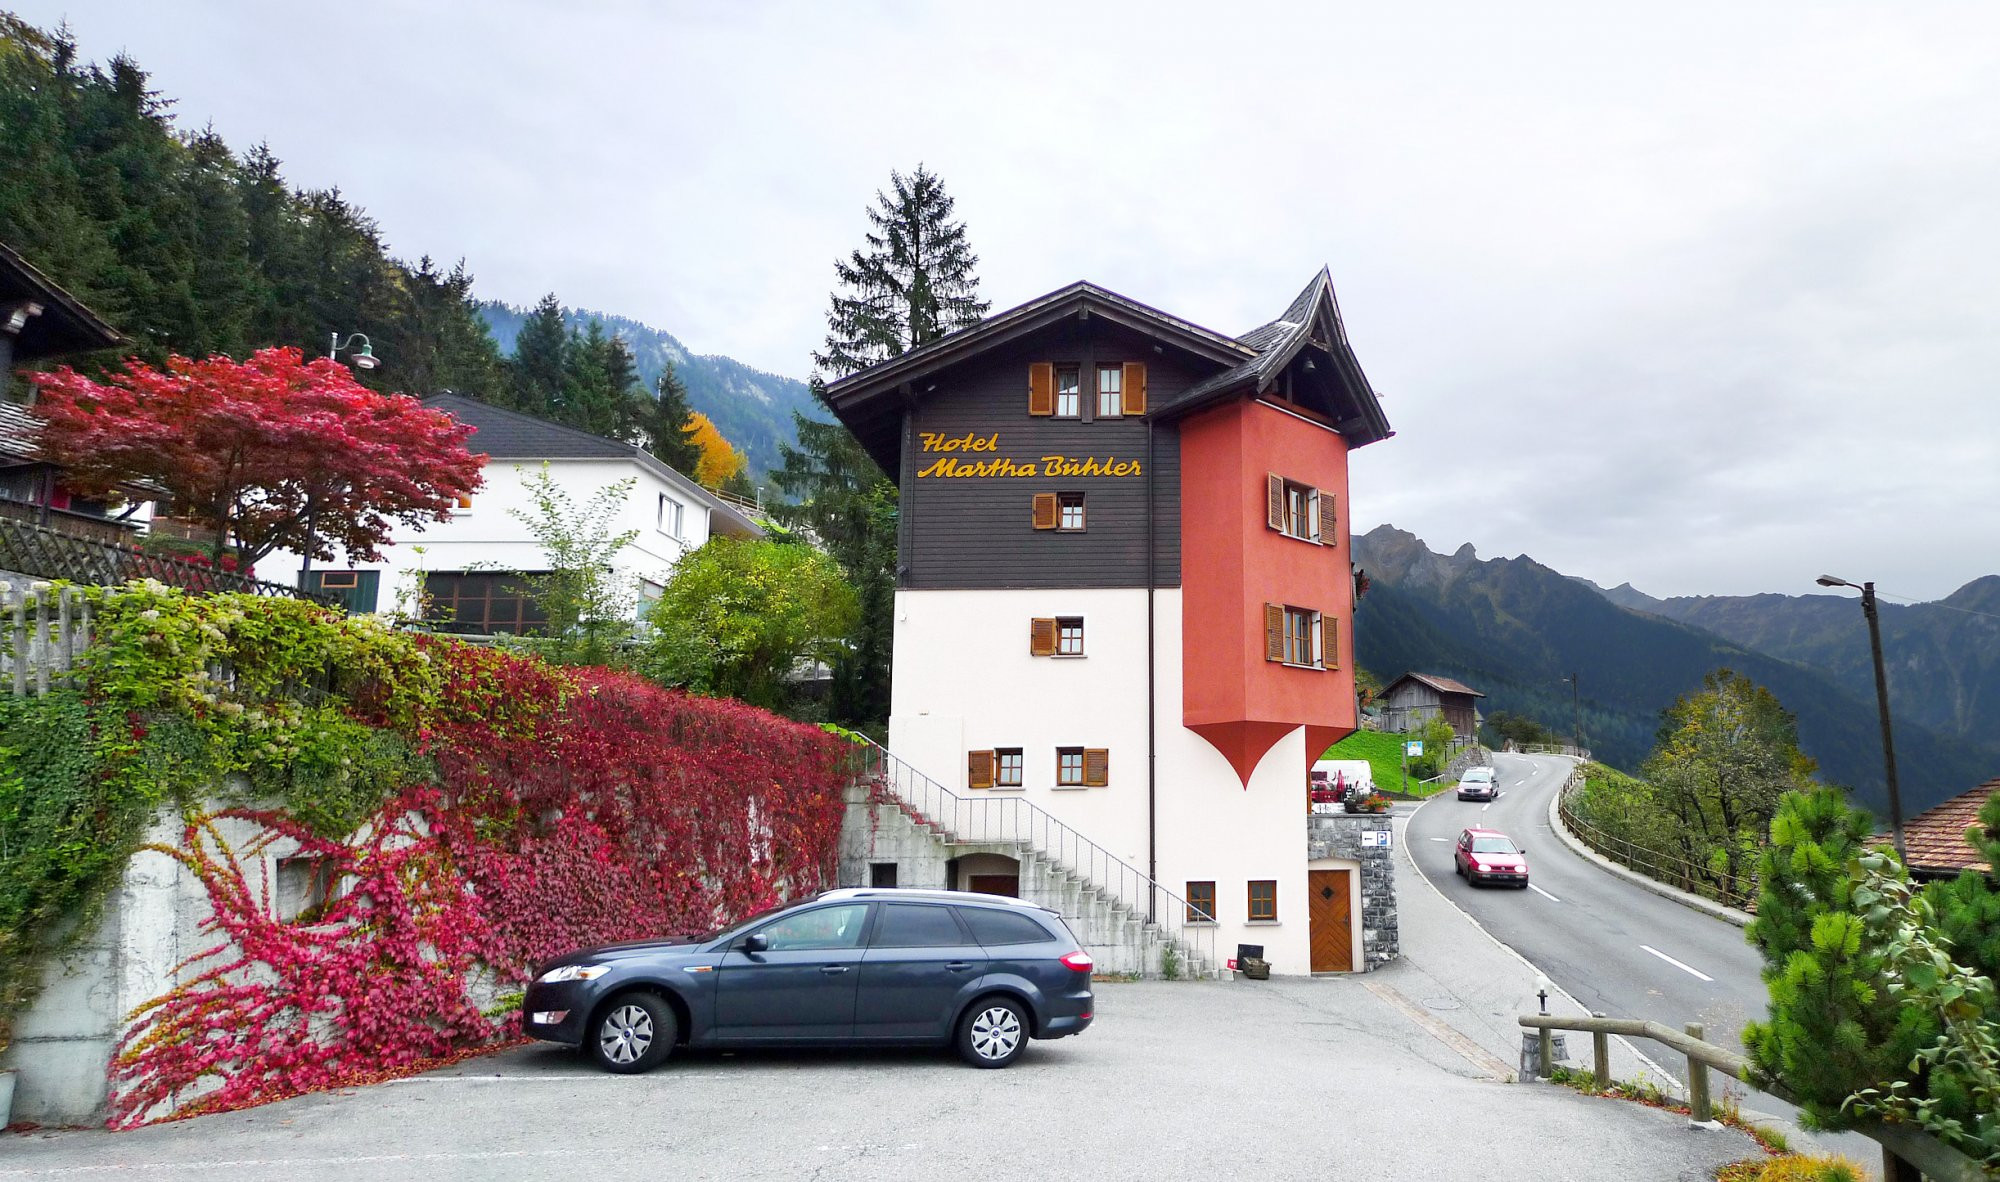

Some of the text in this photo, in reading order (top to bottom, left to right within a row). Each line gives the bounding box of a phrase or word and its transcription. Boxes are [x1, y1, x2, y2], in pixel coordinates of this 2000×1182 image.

[919, 432, 998, 452] Hotel
[917, 455, 1142, 478] Martha Bühler
[1378, 833, 1386, 844] P
